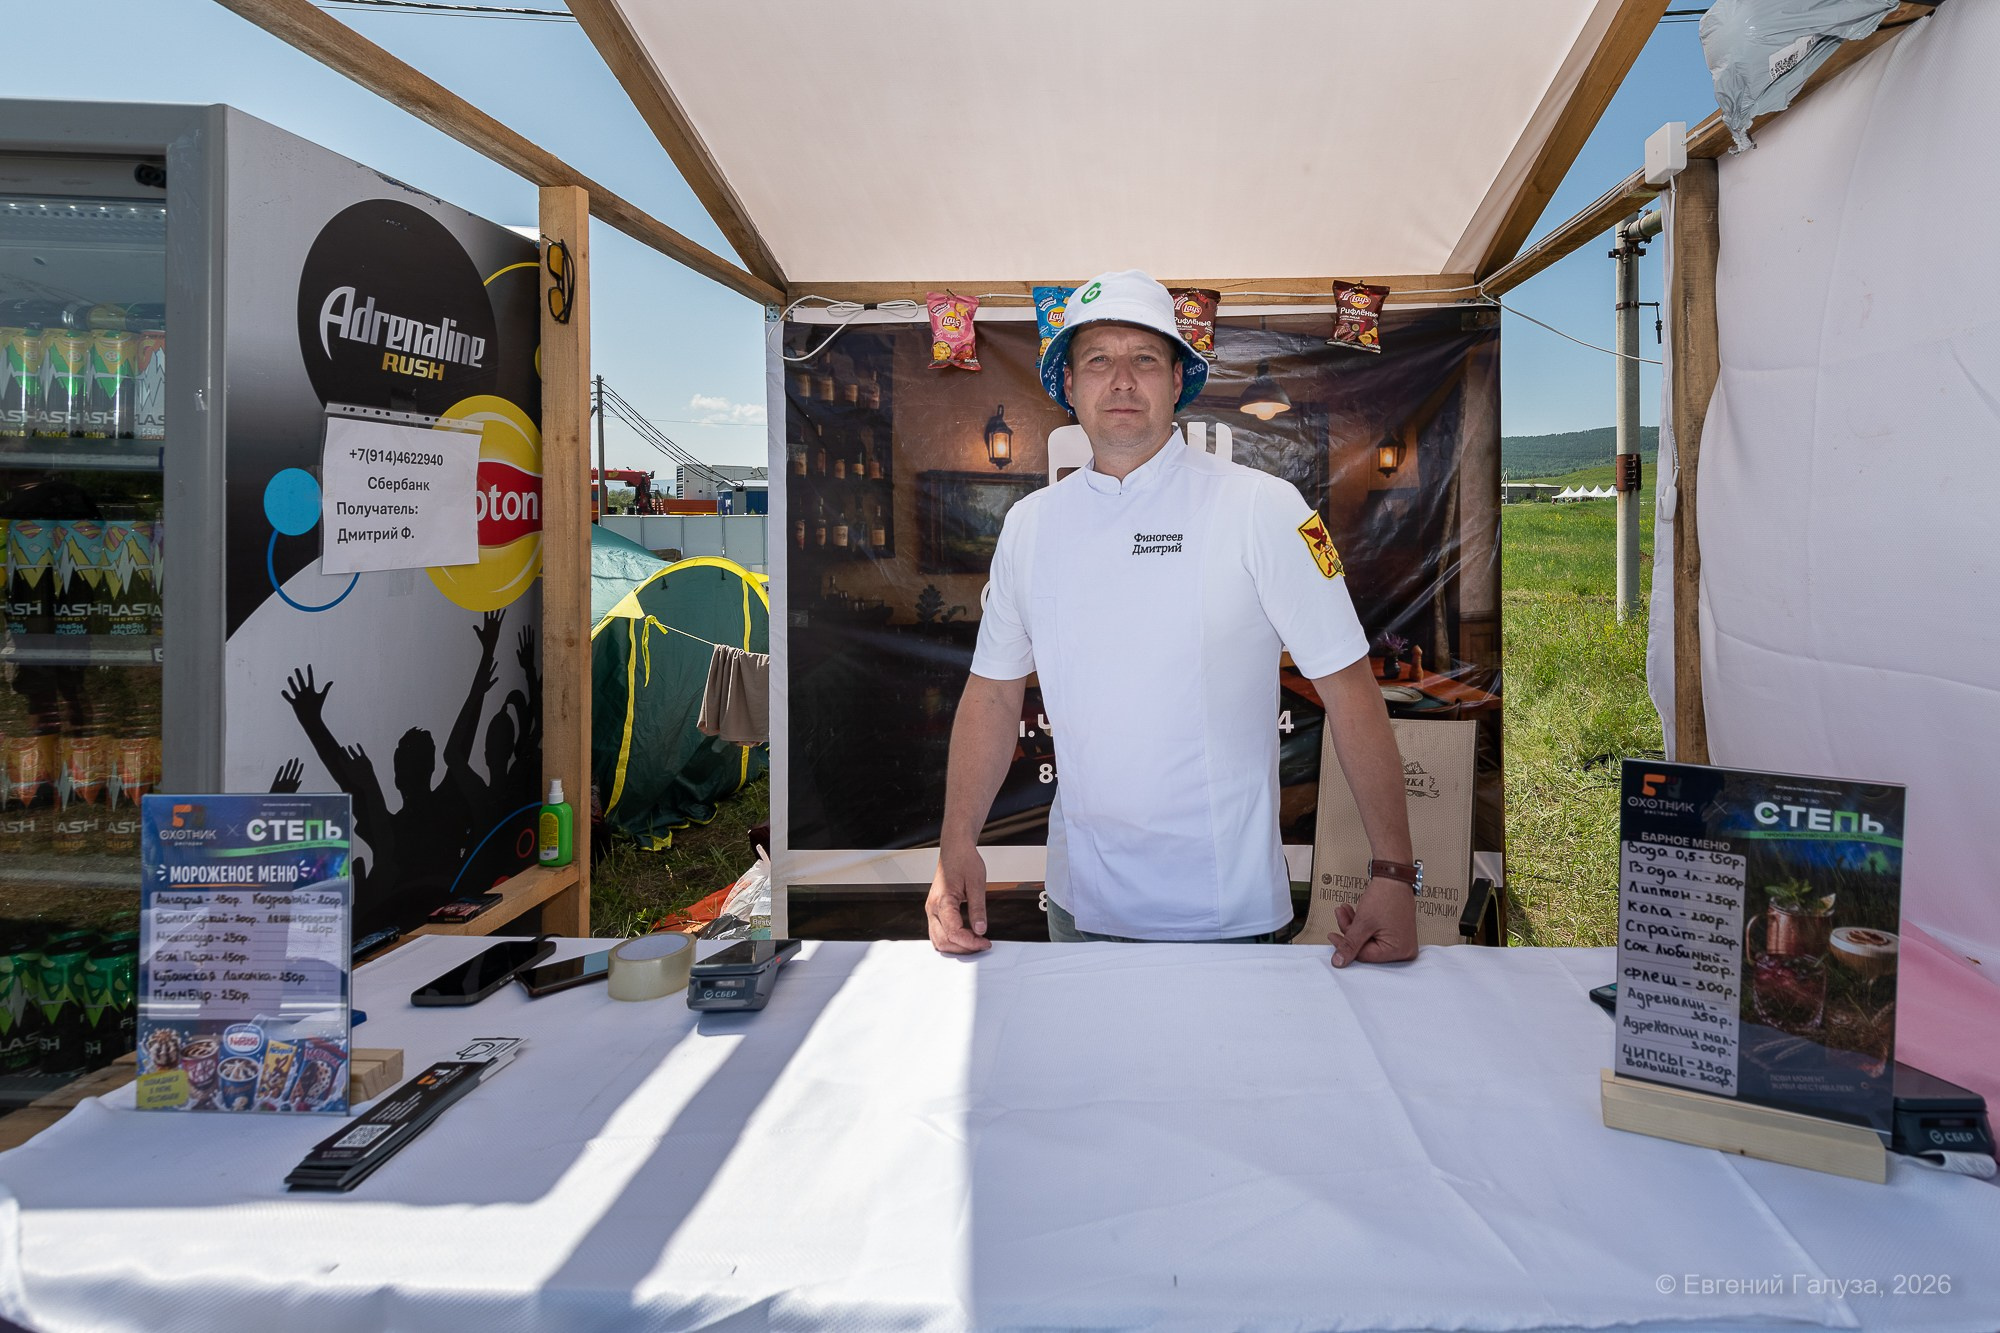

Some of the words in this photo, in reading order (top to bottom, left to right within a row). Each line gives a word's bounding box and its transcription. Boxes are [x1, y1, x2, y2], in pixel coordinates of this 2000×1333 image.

[319, 286, 485, 368] Adrenaline
[381, 352, 445, 381] RUSH
[349, 448, 444, 467] +7(914)4622940
[367, 476, 430, 491] Сбербанк
[336, 501, 418, 518] Получатель:
[337, 526, 398, 544] Дмитрий
[401, 526, 415, 540] Ф.
[1134, 532, 1183, 543] Финогеев
[1132, 543, 1182, 555] Дмитрий
[1627, 796, 1695, 813] ОХОТНИК
[1754, 801, 1884, 835] СТЕПЬ
[159, 829, 217, 840] ОХОТНИК
[247, 819, 342, 842] СТЕПЬ
[1641, 832, 1690, 847] БАРНОЕ
[1692, 838, 1731, 851] МЕНЮ
[1627, 841, 1668, 861] Вода
[1675, 850, 1697, 862] 0,5
[170, 865, 254, 883] МОРОЖЕНОЕ
[258, 864, 299, 883] МЕНЮ
[1629, 860, 1677, 885] Вода
[1319, 887, 1363, 904] ПОТРЕБЛЕНИ
[1629, 881, 1691, 900] Липтон
[1627, 900, 1673, 918] Кола
[1625, 919, 1696, 939] Спрайт
[1624, 939, 1650, 953] Сок
[1655, 943, 1720, 962] Любимый
[715, 990, 738, 999] СБЕР
[1627, 987, 1706, 1011] Адреналин
[1944, 1132, 1974, 1143] СБЕР
